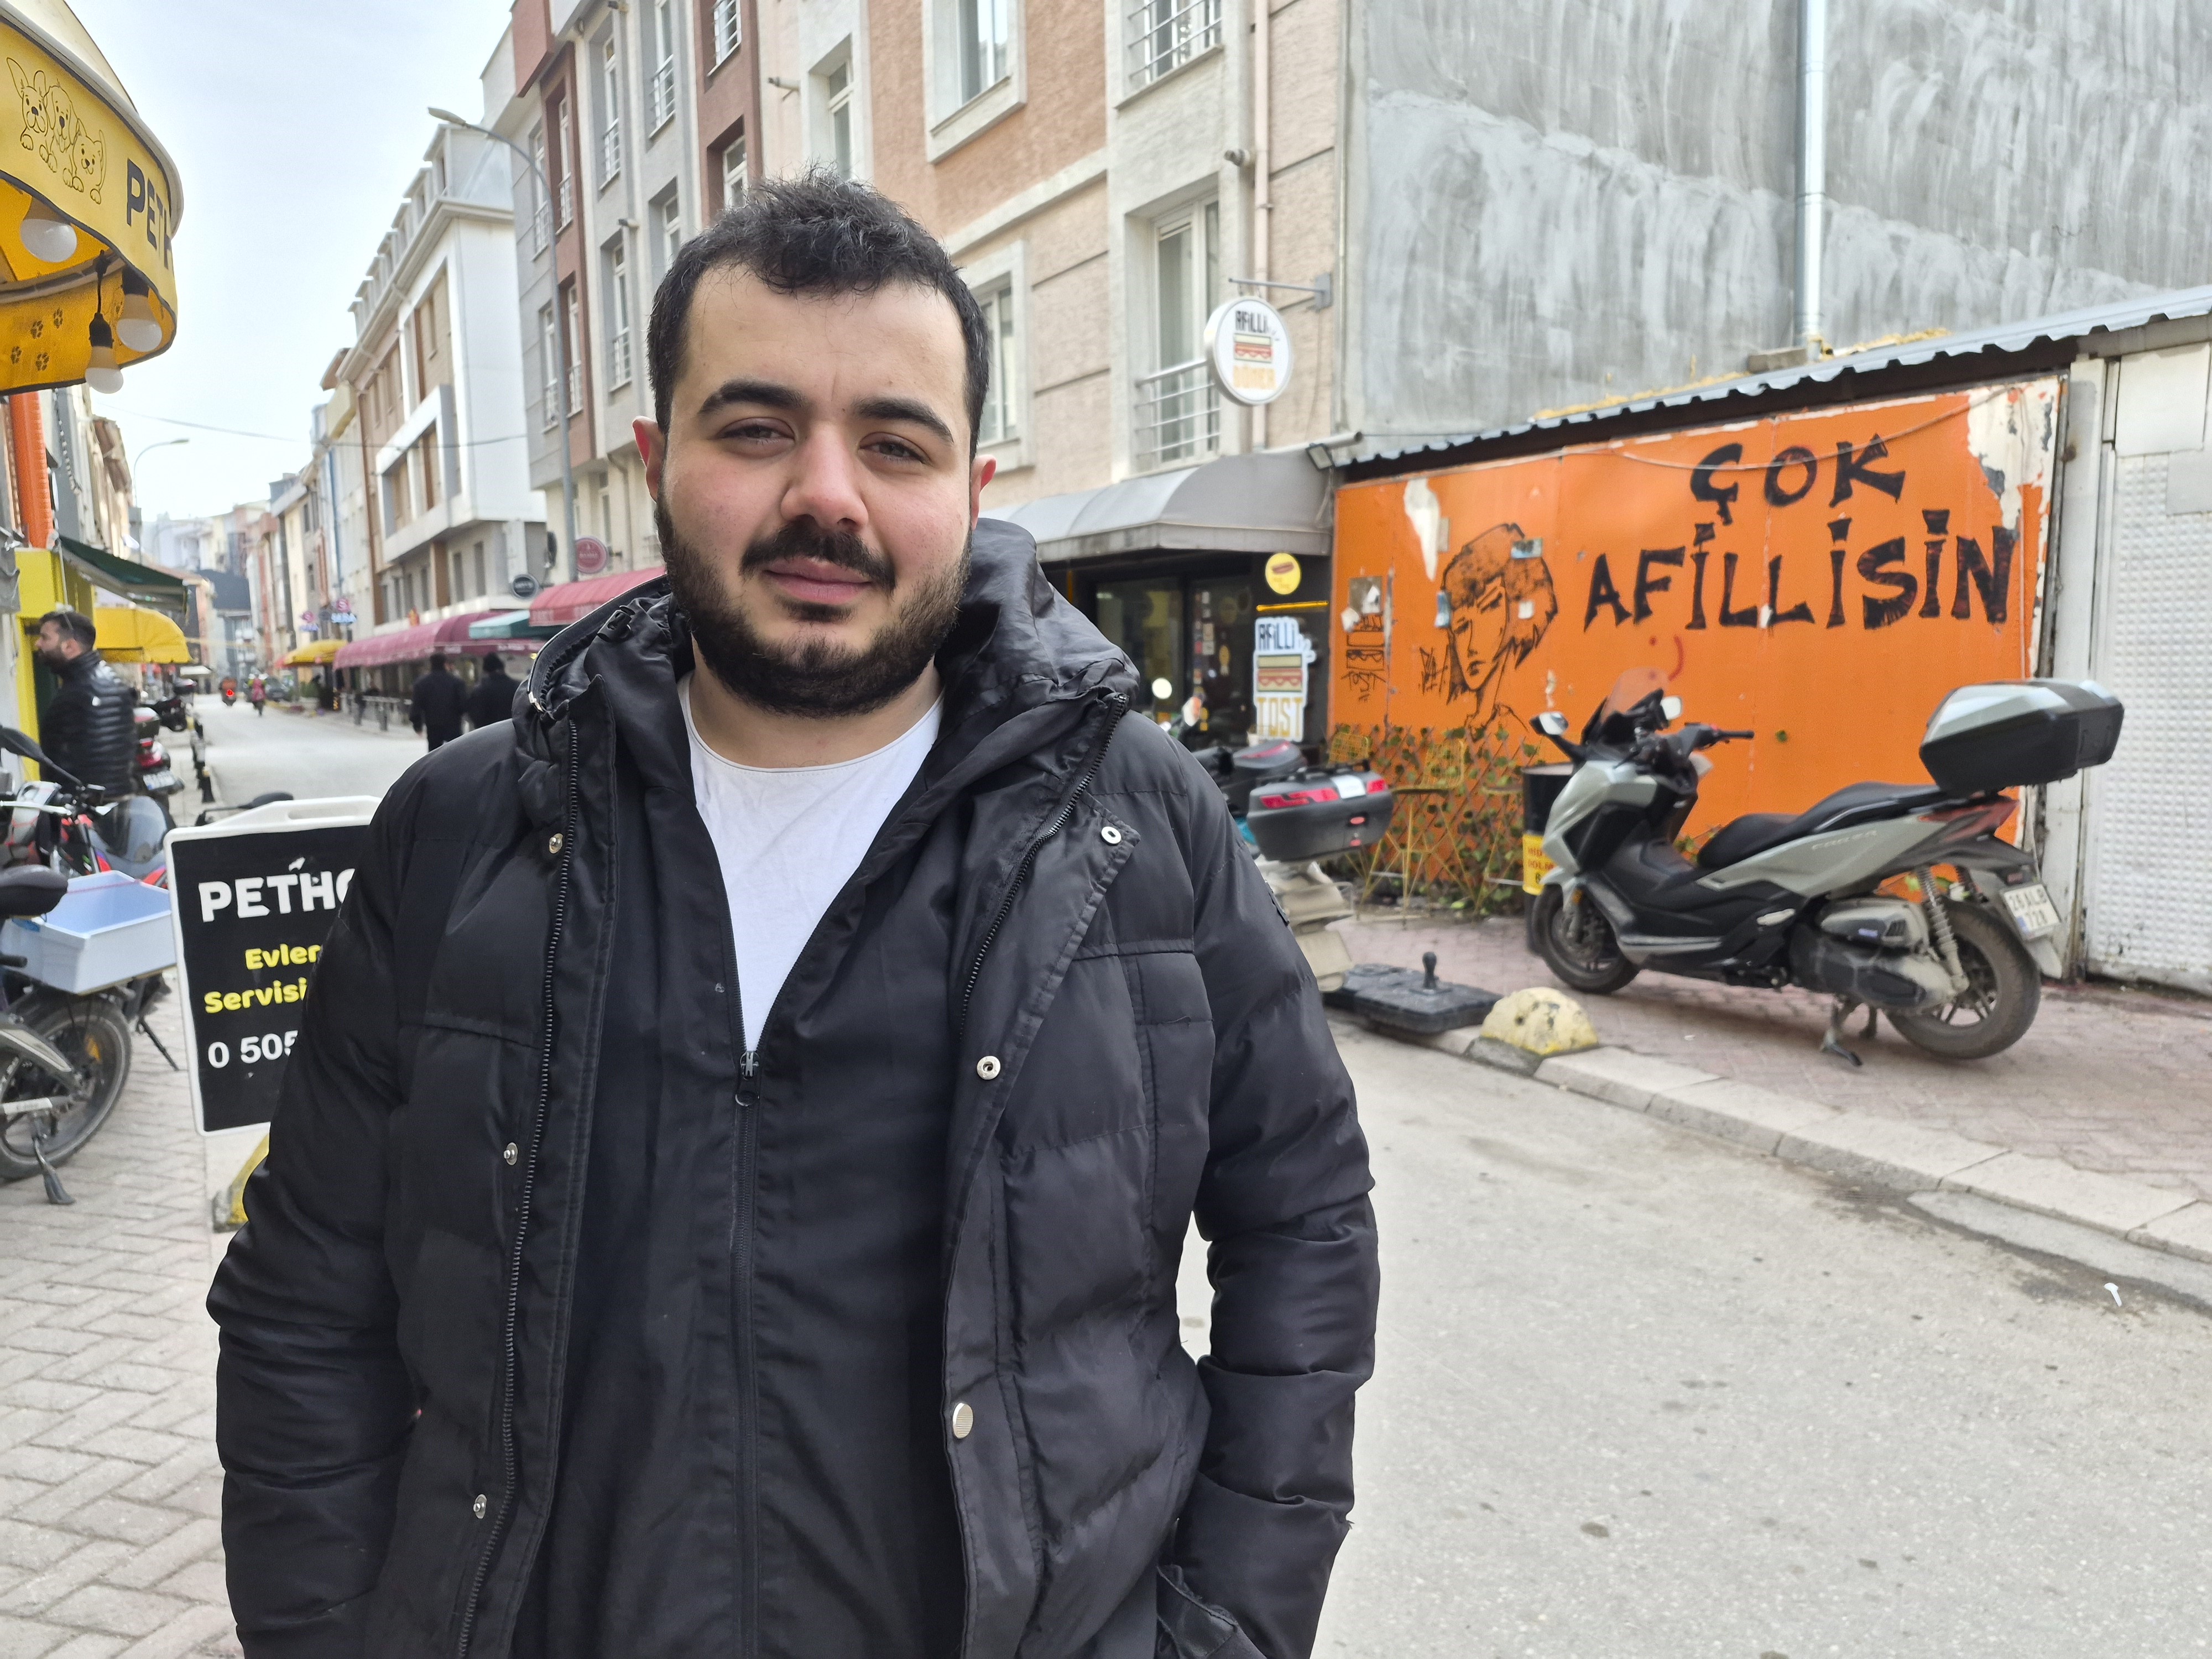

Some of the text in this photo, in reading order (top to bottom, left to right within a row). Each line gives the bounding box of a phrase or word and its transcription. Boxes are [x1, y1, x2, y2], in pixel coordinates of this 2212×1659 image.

[1690, 433, 1906, 525] ÇOK
[1584, 509, 2016, 632] AFİLLİSİN
[1258, 696, 1303, 738] TOST
[207, 1041, 230, 1068] 0
